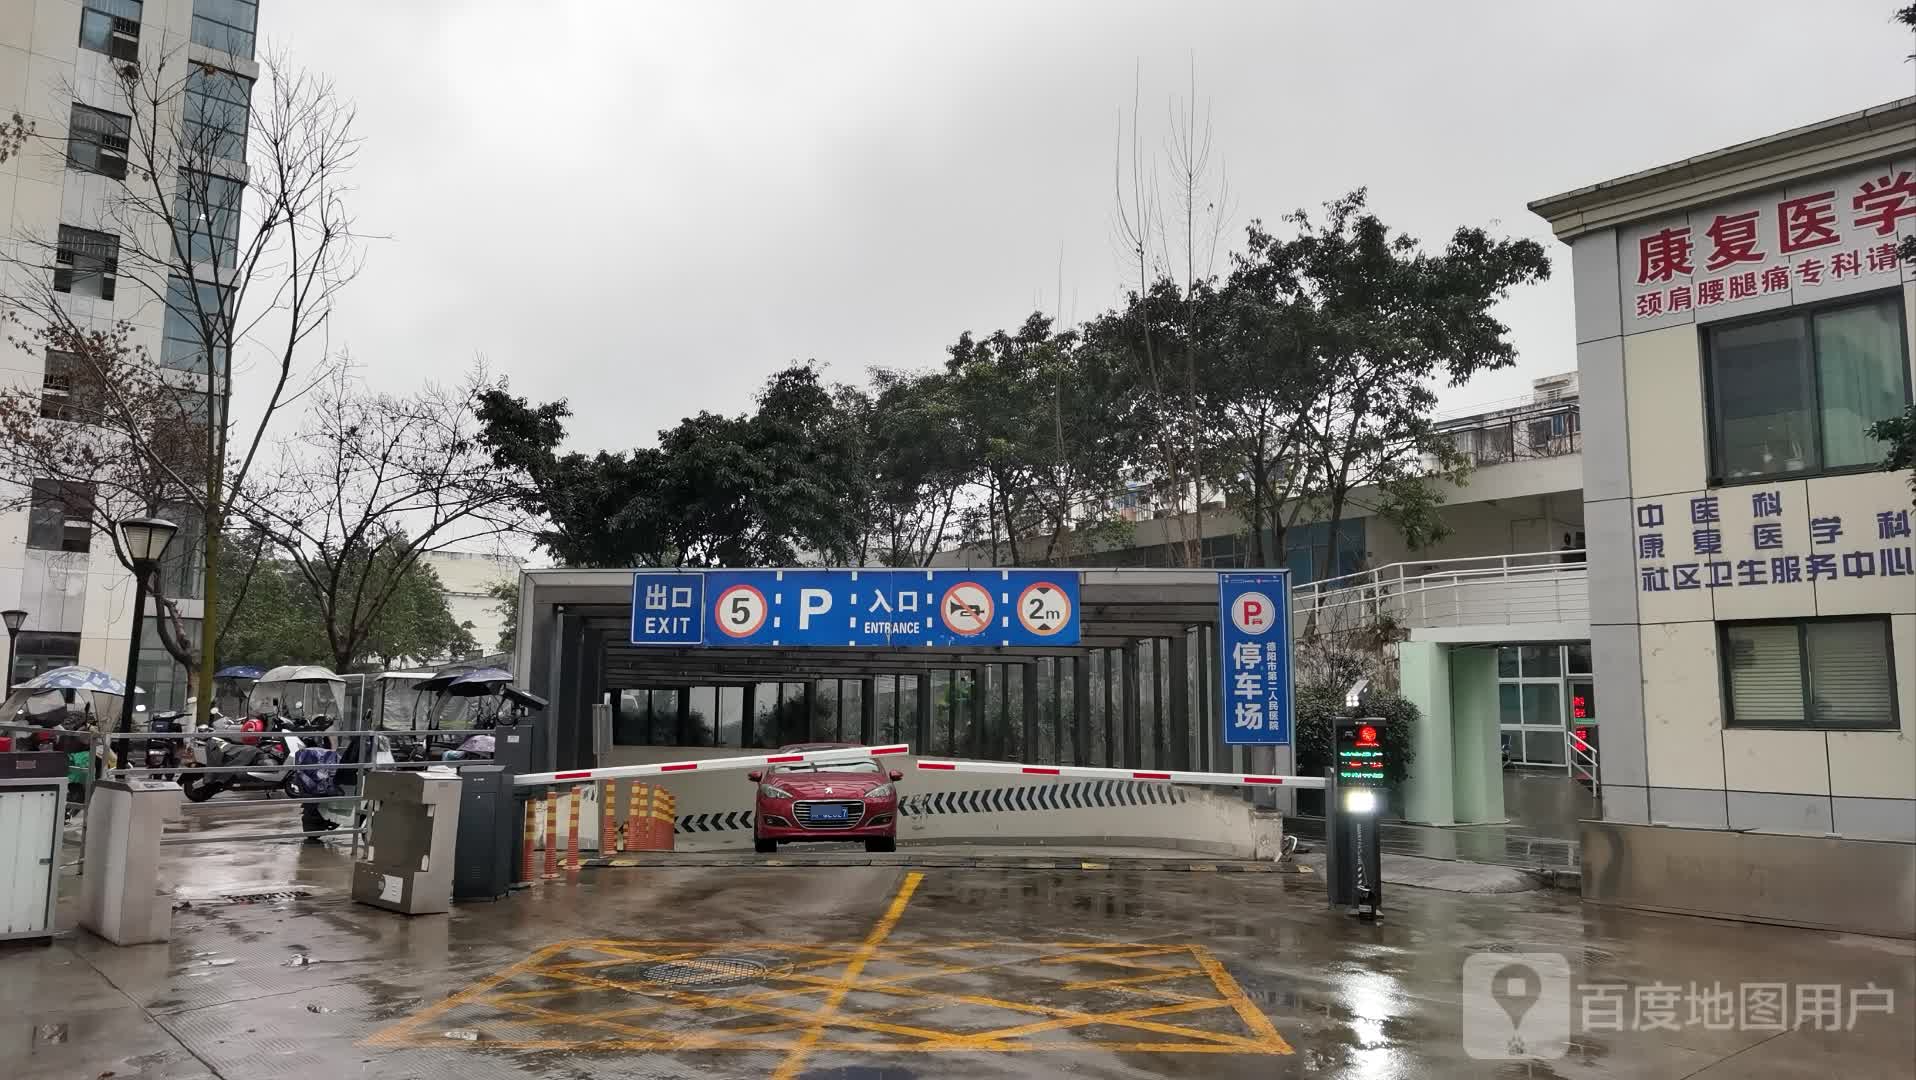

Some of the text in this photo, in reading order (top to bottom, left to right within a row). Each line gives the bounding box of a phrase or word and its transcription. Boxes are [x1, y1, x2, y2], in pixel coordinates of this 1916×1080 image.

[1635, 242, 1916, 318] 颈肩腰腿痛专科请
[1637, 490, 1783, 529] 中医科
[1642, 546, 1914, 593] 社区卫生服务中心
[645, 583, 692, 611] 出口
[731, 597, 751, 625] 5
[800, 588, 833, 630] P
[868, 589, 918, 613] 入口
[1029, 599, 1061, 621] 2m
[645, 617, 690, 634] EXIT
[1243, 600, 1262, 626] P
[864, 621, 920, 634] ENTRANCE
[1232, 641, 1264, 731] 停车场
[1266, 641, 1279, 731] 德阳市第二人民医院
